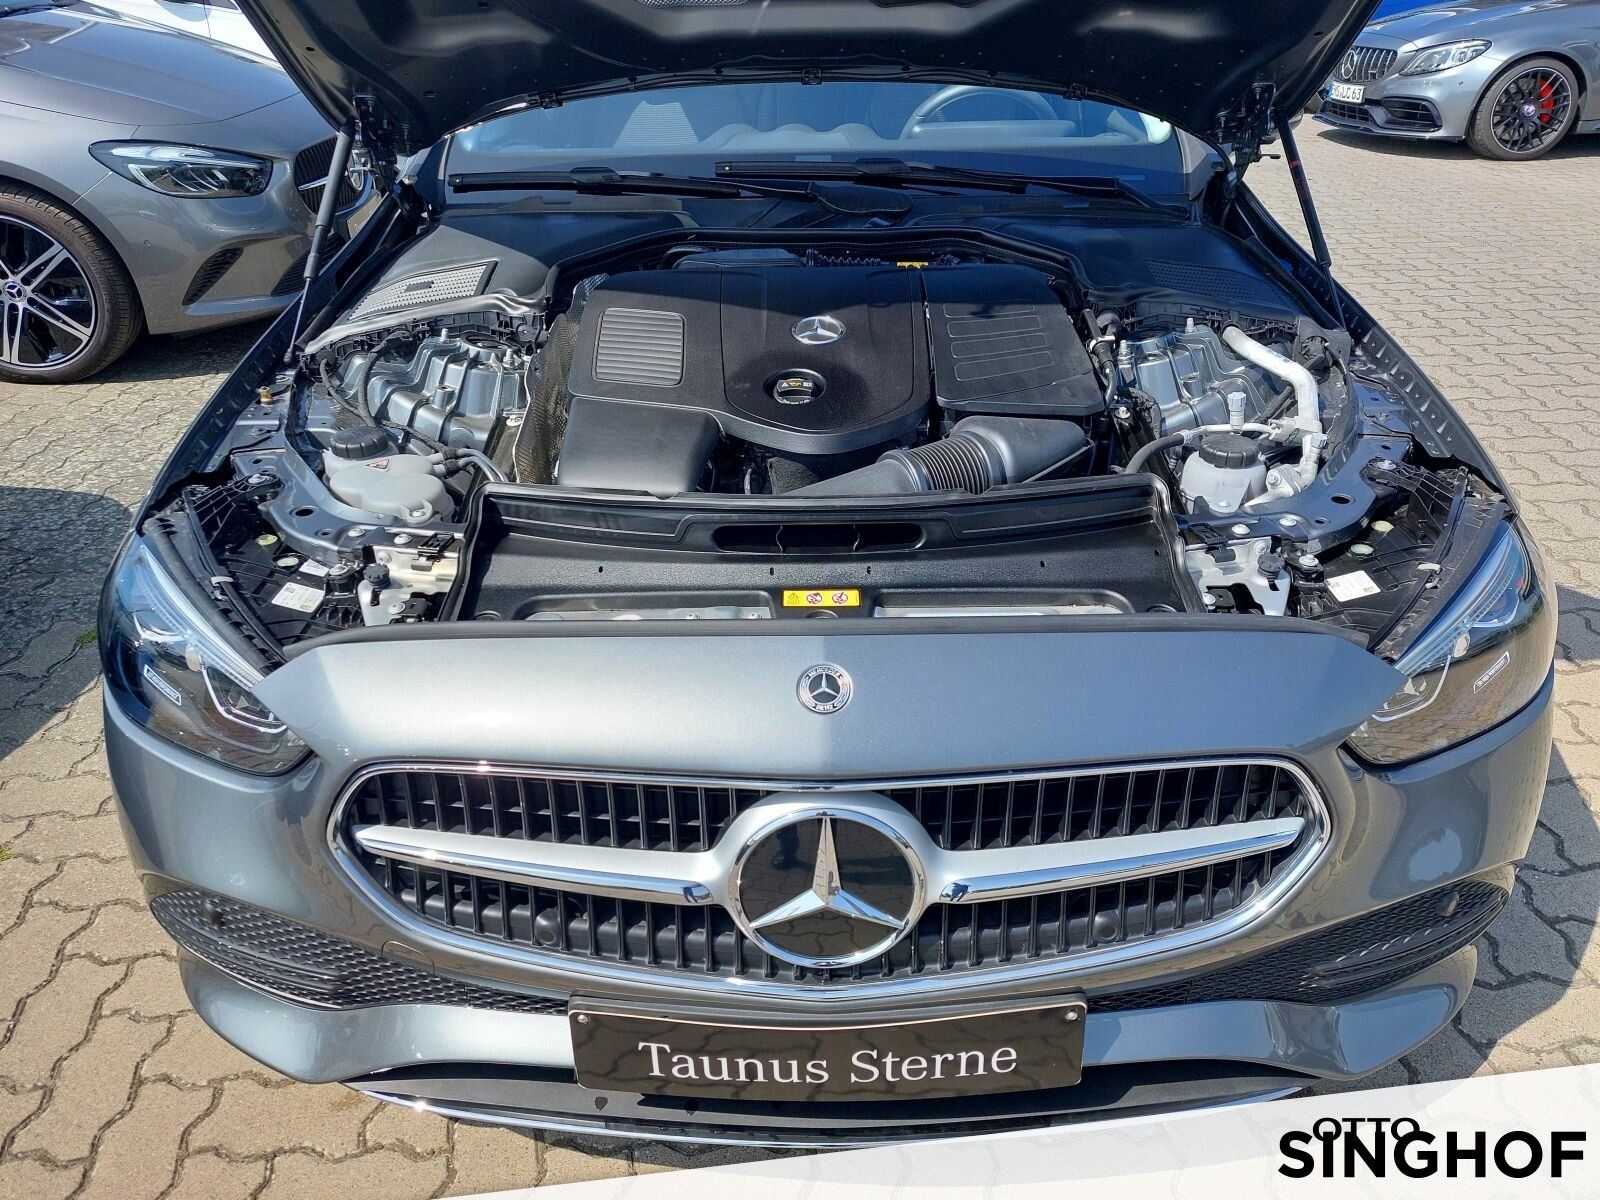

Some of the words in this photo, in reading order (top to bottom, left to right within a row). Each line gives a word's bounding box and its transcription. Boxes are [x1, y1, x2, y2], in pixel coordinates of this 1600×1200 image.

[1351, 88, 1362, 101] 63
[638, 1041, 829, 1084] Taunus
[851, 1046, 1018, 1084] Sterne
